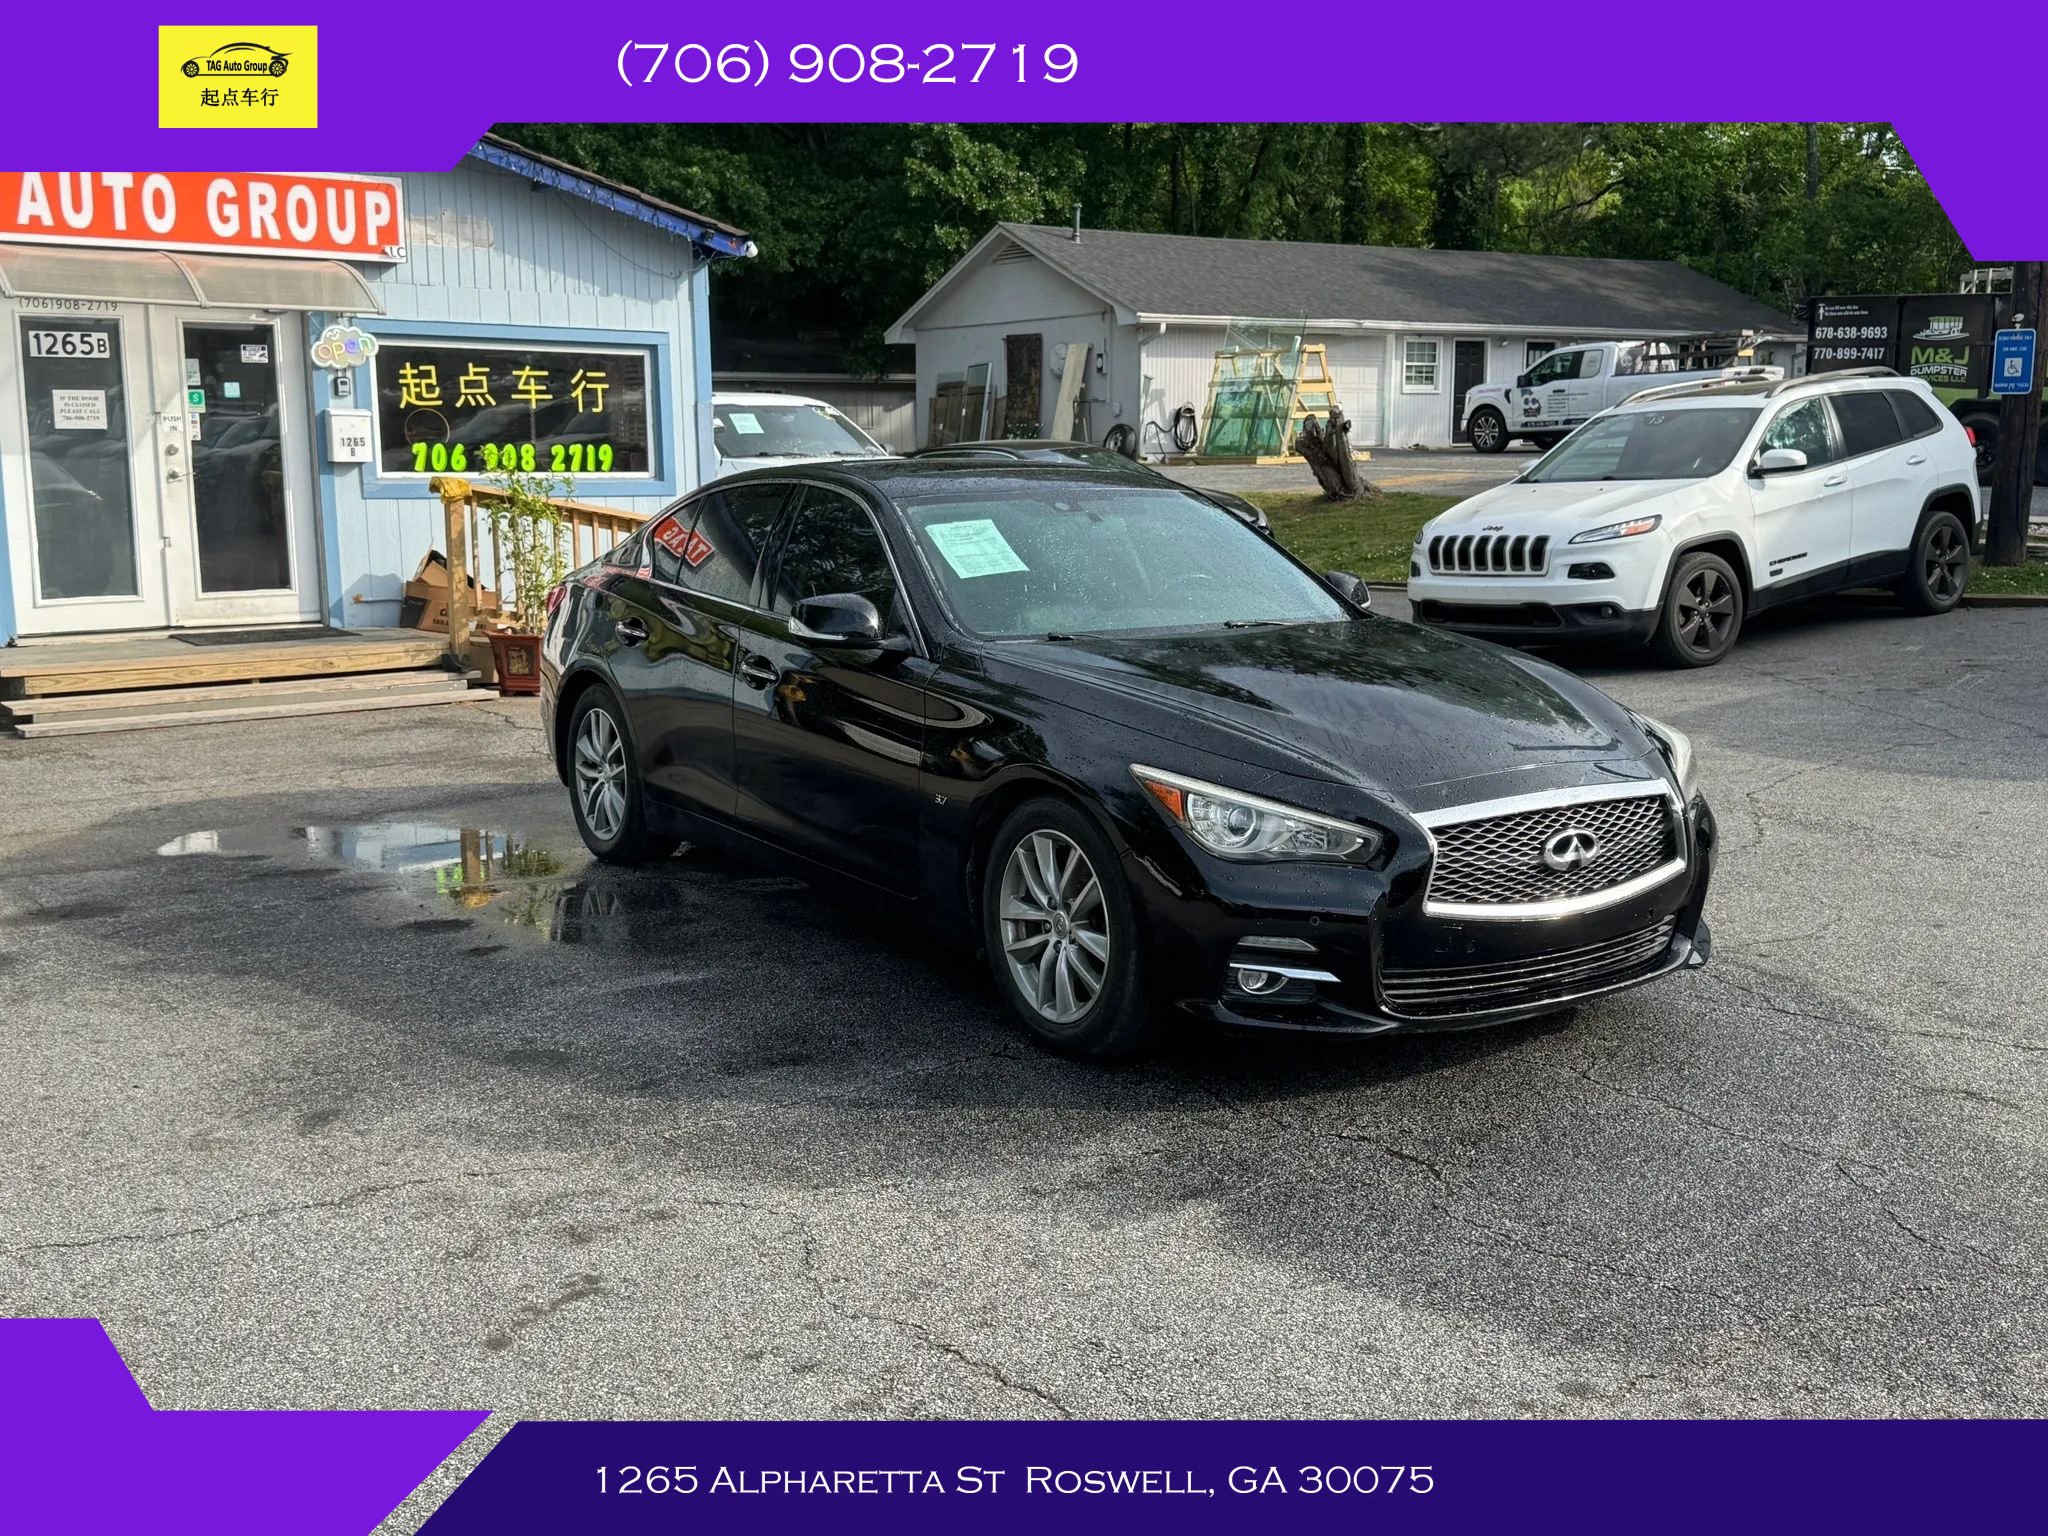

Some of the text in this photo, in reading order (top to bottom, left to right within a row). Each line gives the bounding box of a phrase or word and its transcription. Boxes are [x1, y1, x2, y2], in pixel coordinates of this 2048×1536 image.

[16, 172, 391, 246] AUTO GROUP
[19, 297, 118, 312] (706)908-2719
[1815, 326, 1888, 339] 678-638-9693
[1814, 347, 1885, 360] 770-899-7417
[1911, 345, 1970, 365] M&J
[1910, 365, 1967, 377] DUMPSTER
[398, 361, 611, 413] 起点车行
[340, 437, 366, 448] 1265
[412, 442, 467, 472] 706
[551, 443, 613, 472] 2719
